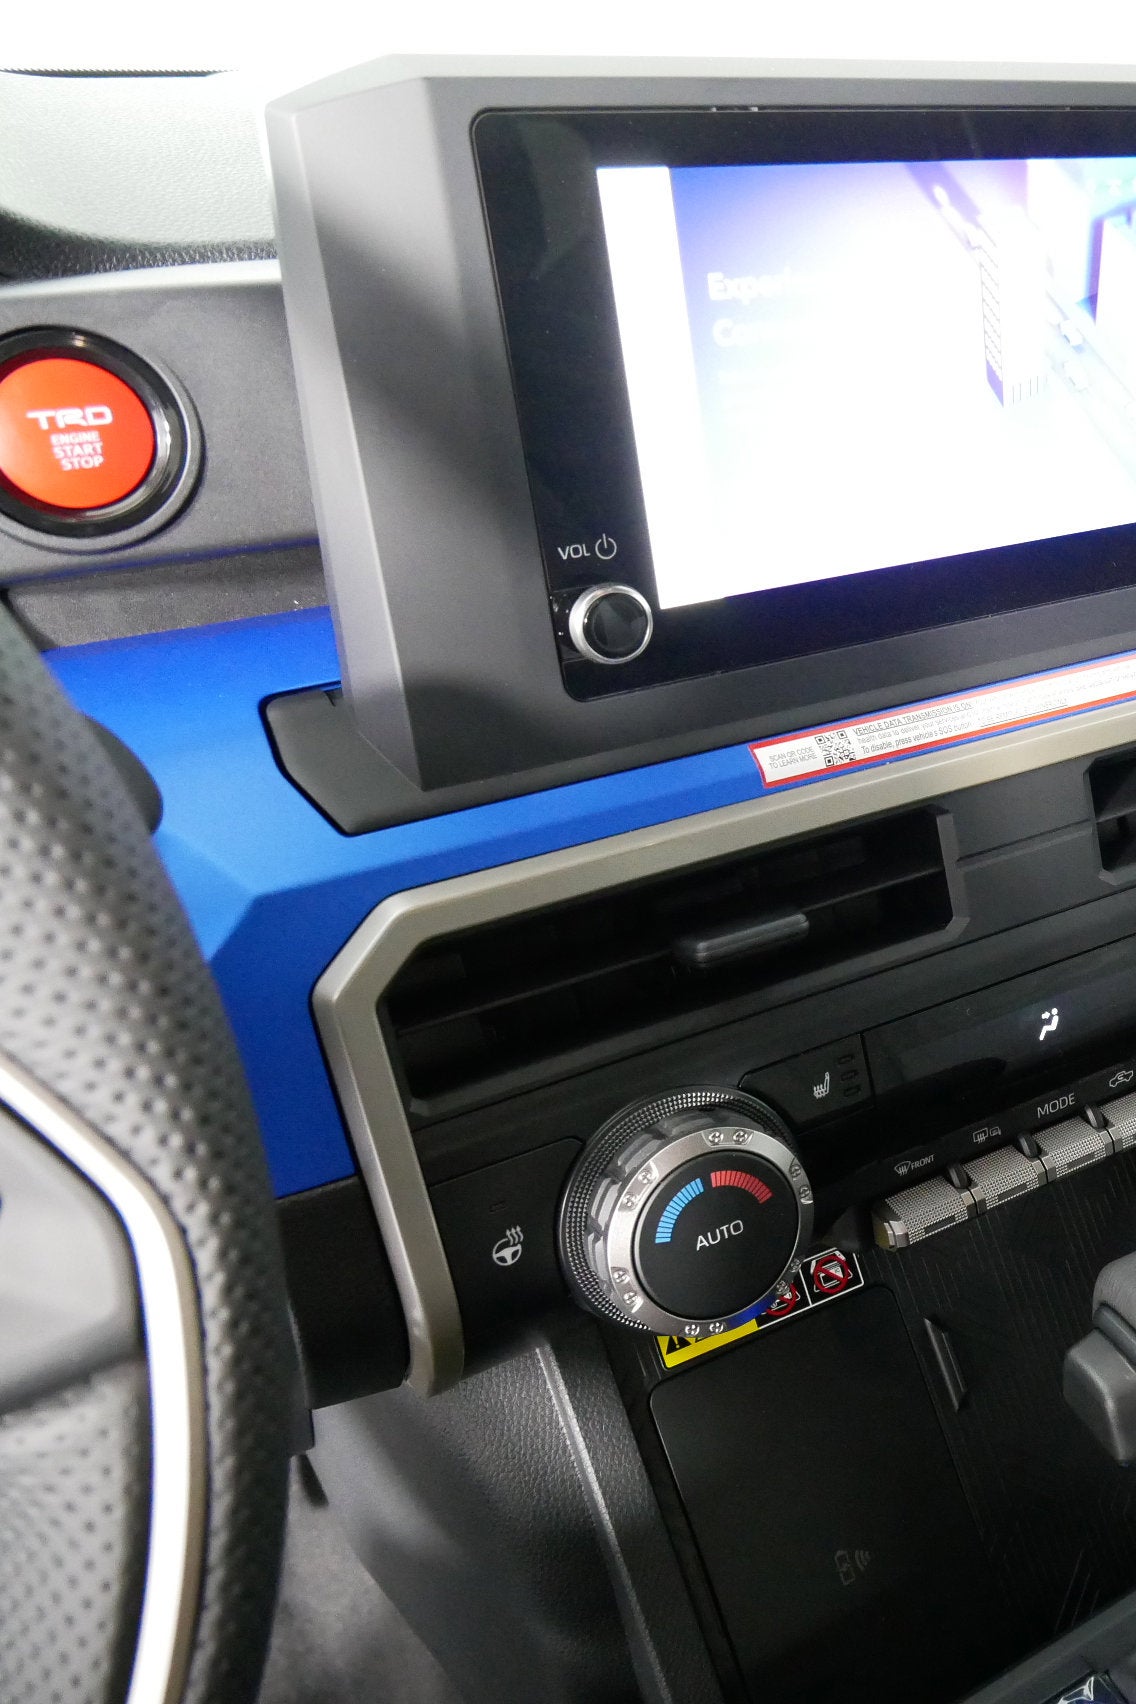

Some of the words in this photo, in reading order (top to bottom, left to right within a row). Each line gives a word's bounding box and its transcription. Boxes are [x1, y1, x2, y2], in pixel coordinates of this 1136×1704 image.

[26, 405, 113, 430] TRD
[50, 431, 101, 446] ENGINE
[53, 442, 103, 459] START
[61, 455, 104, 471] STOP
[557, 543, 591, 560] VOL
[853, 722, 882, 737] VEHICLE
[883, 718, 901, 729] DATA
[902, 706, 952, 723] TRANSMISSION
[861, 746, 870, 754] To
[895, 736, 912, 748] press
[939, 724, 953, 735] SOS
[878, 731, 892, 740] data
[769, 752, 786, 762] SCAN
[797, 746, 814, 756] CODE
[779, 757, 799, 767] LEARN
[799, 753, 817, 762] MORE
[1037, 1092, 1076, 1119] MODE
[910, 1153, 935, 1170] FRONT
[696, 1219, 744, 1251] AUTO
